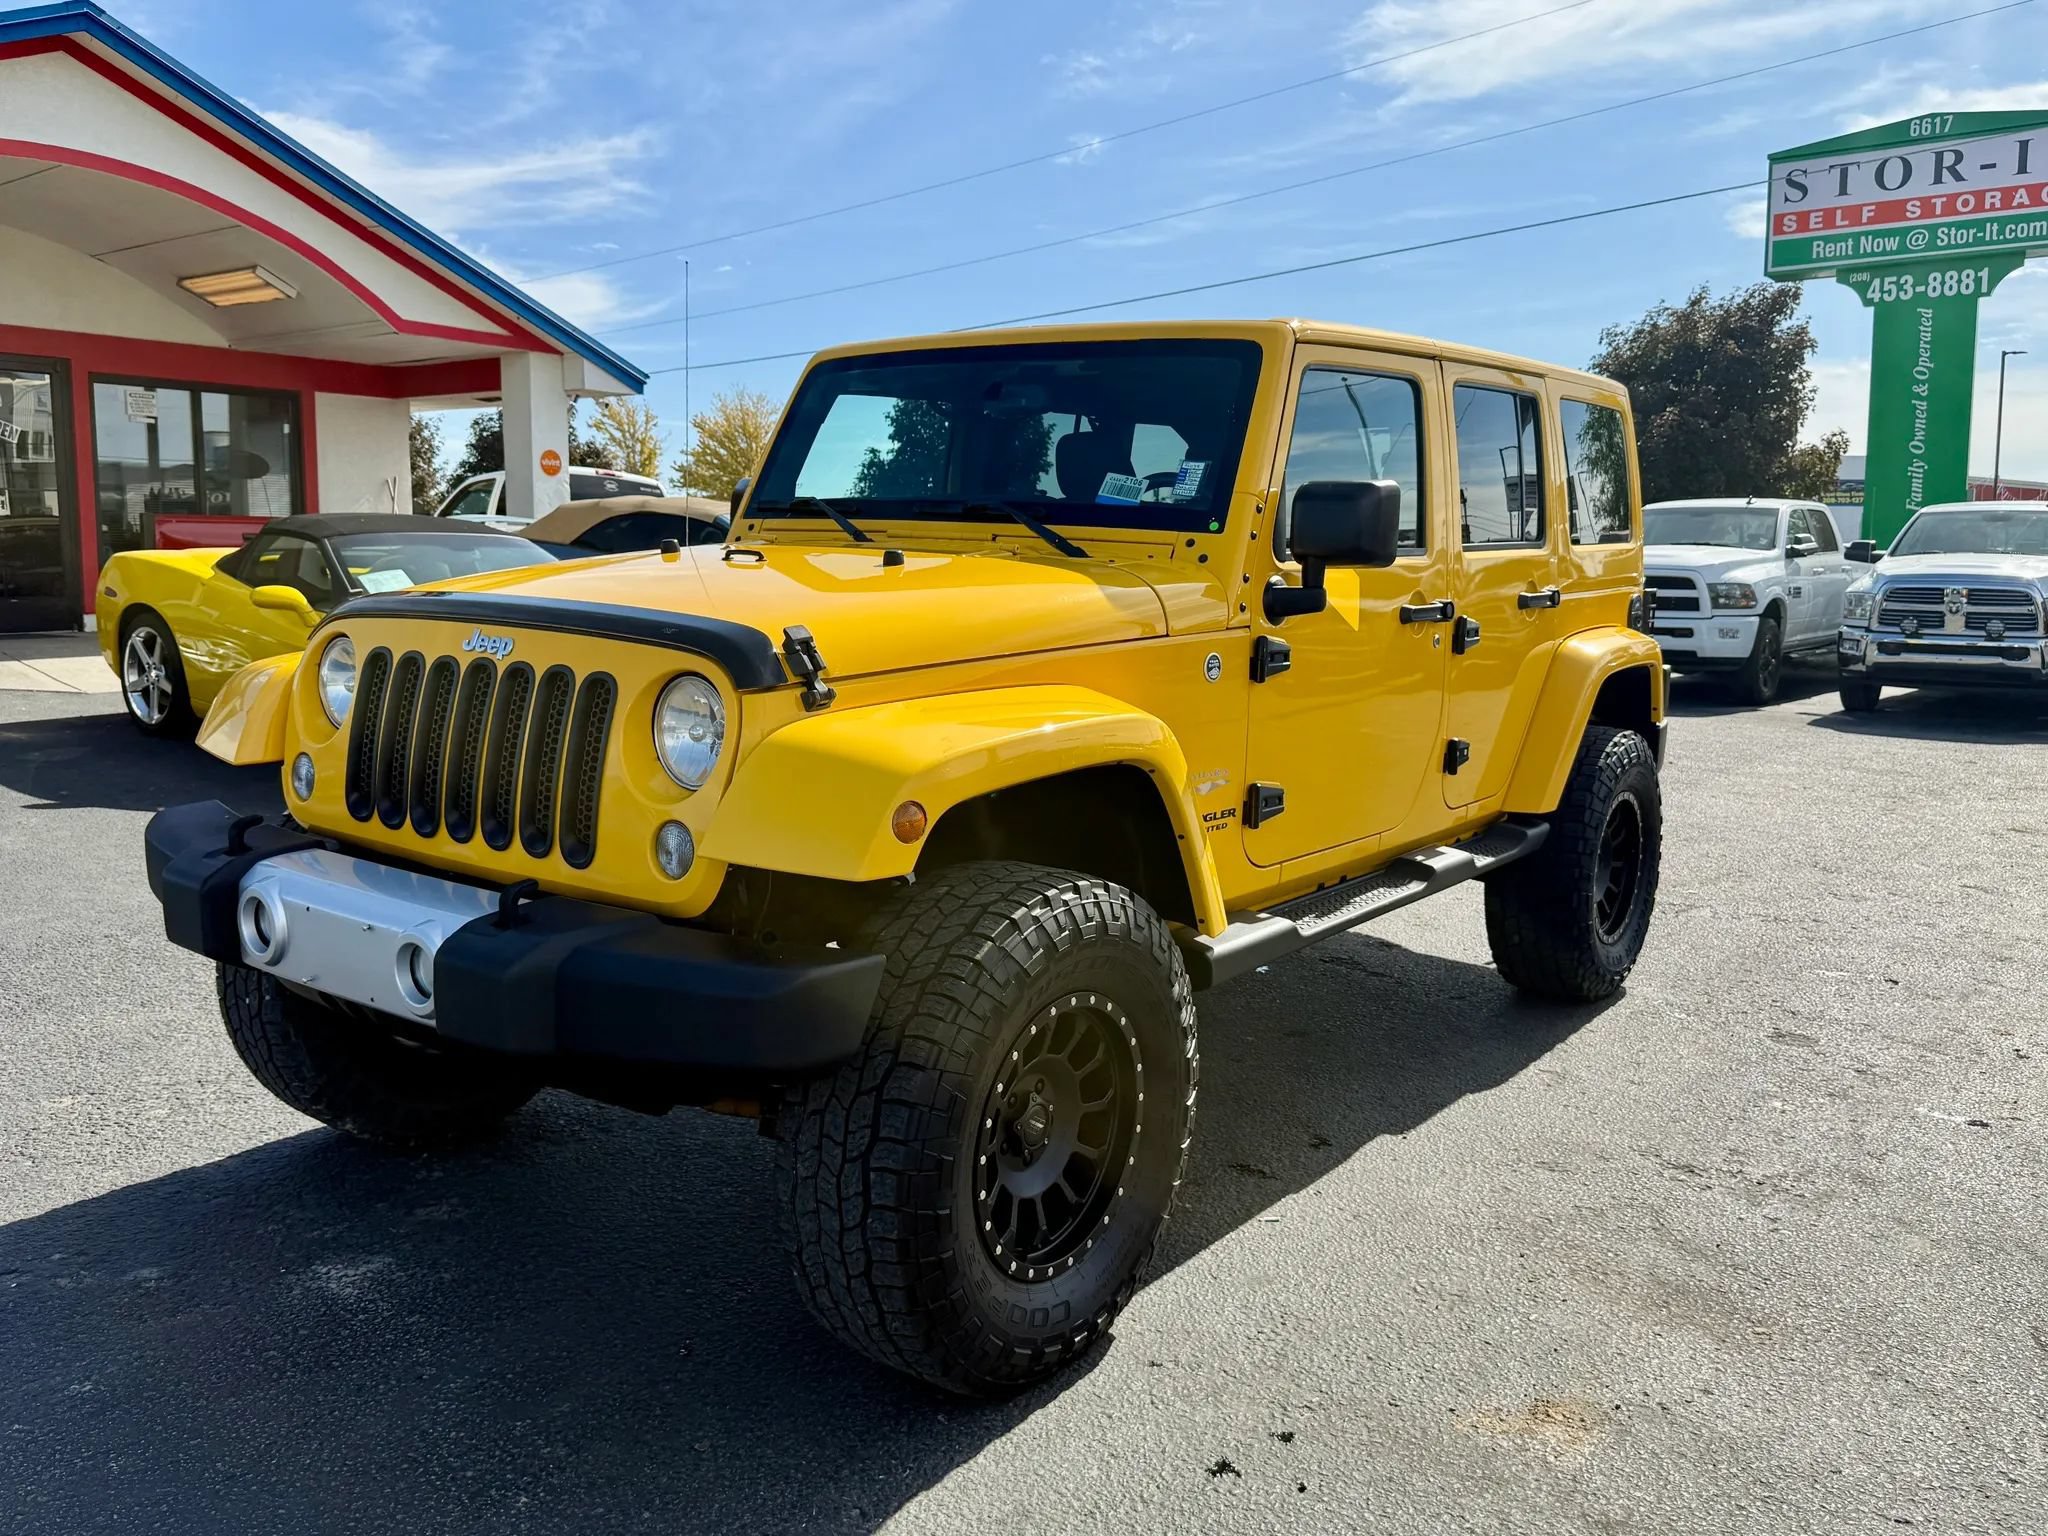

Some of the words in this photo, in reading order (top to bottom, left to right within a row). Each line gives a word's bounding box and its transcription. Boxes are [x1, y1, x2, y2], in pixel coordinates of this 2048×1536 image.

[1909, 115, 1953, 137] 6617
[1782, 205, 1876, 232] SELF
[1812, 239, 1853, 259] Rent
[1859, 235, 1899, 253] Now
[1906, 229, 1929, 250] @
[1936, 220, 2048, 246] Stor-It.com
[1850, 272, 1870, 283] (208)
[1866, 267, 1989, 303] 453-8881
[1912, 308, 1934, 380] Operated
[1912, 383, 1928, 396] &
[1909, 400, 1927, 454] Owned
[1905, 458, 1928, 511] Family
[462, 628, 514, 660] Jeep
